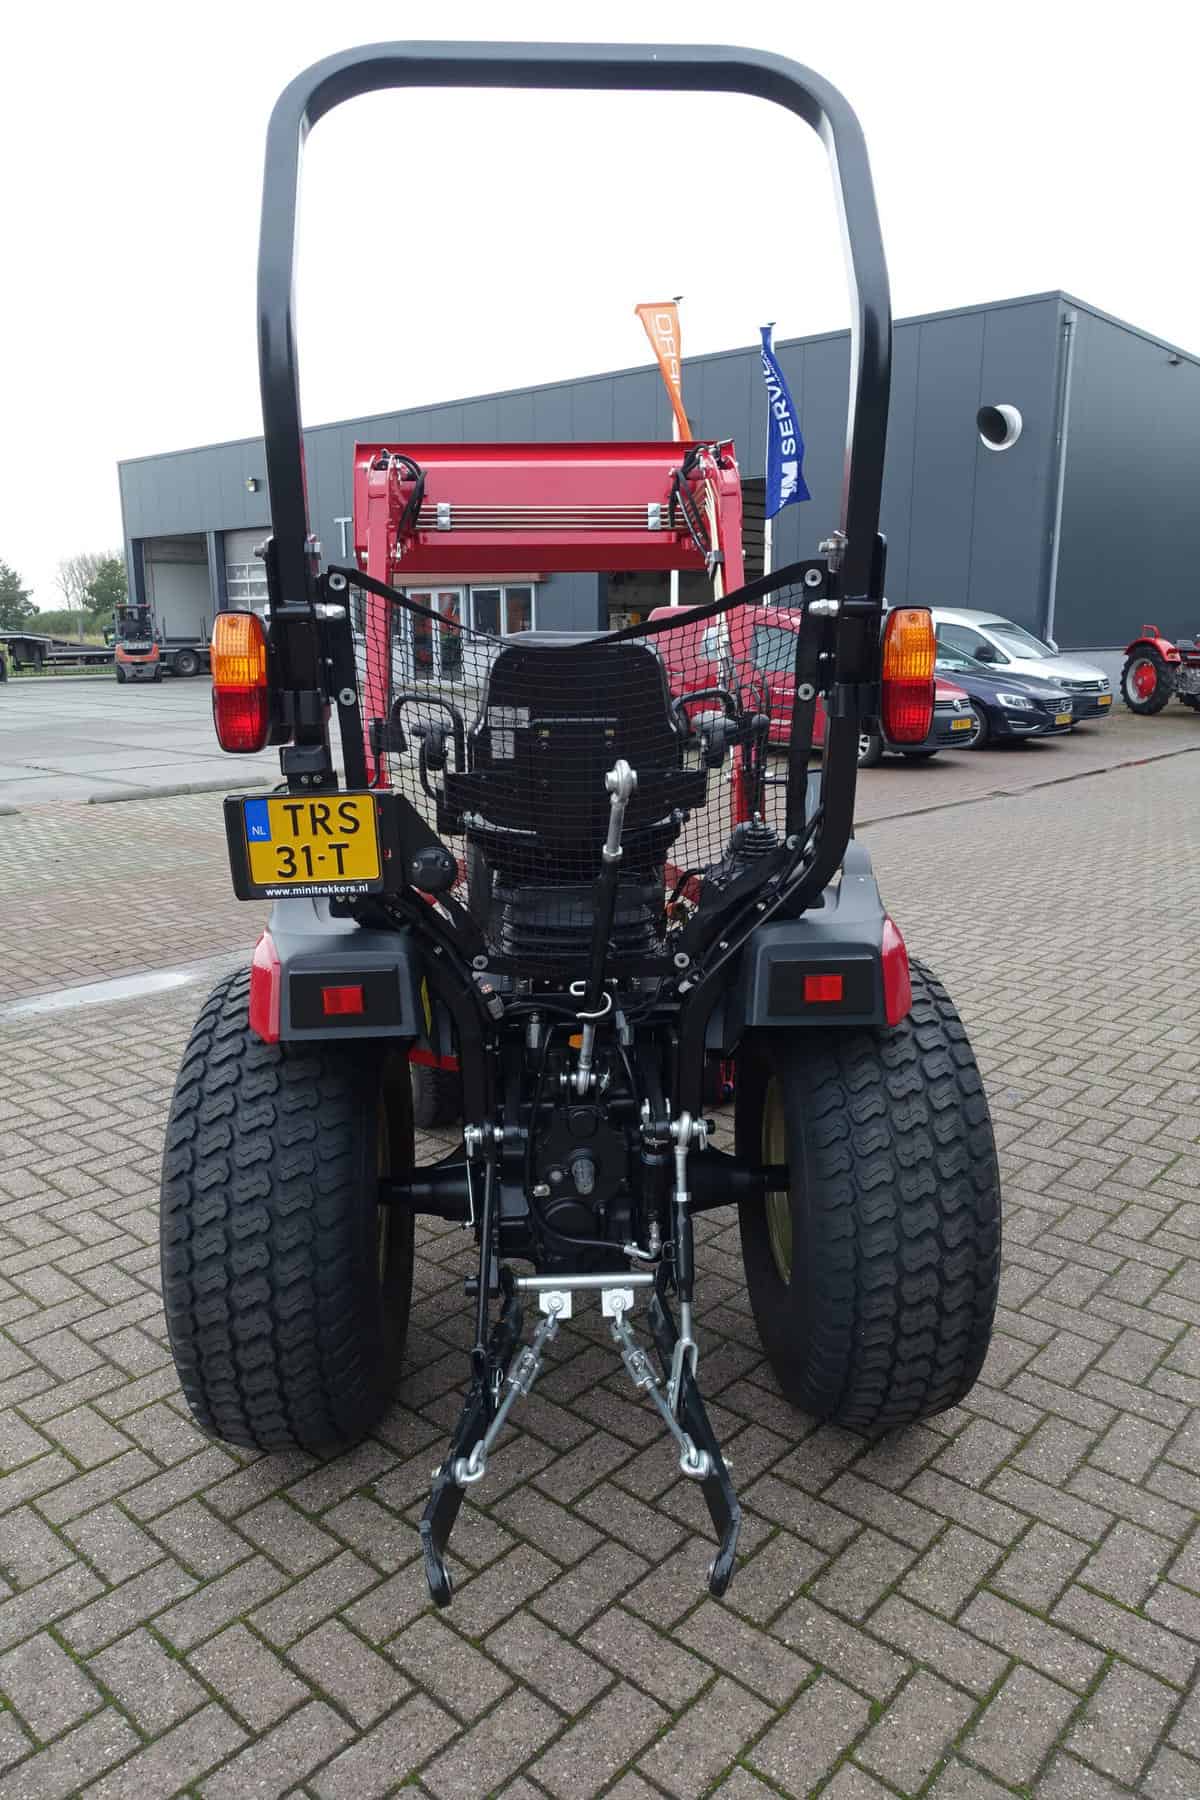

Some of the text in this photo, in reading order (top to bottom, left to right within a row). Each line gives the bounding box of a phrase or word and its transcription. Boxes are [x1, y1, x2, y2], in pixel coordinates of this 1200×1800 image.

[252, 825, 267, 836] NL
[283, 801, 360, 836] TRS
[276, 843, 349, 878] 31-T
[265, 883, 369, 896] www.minitrekkers.nl
